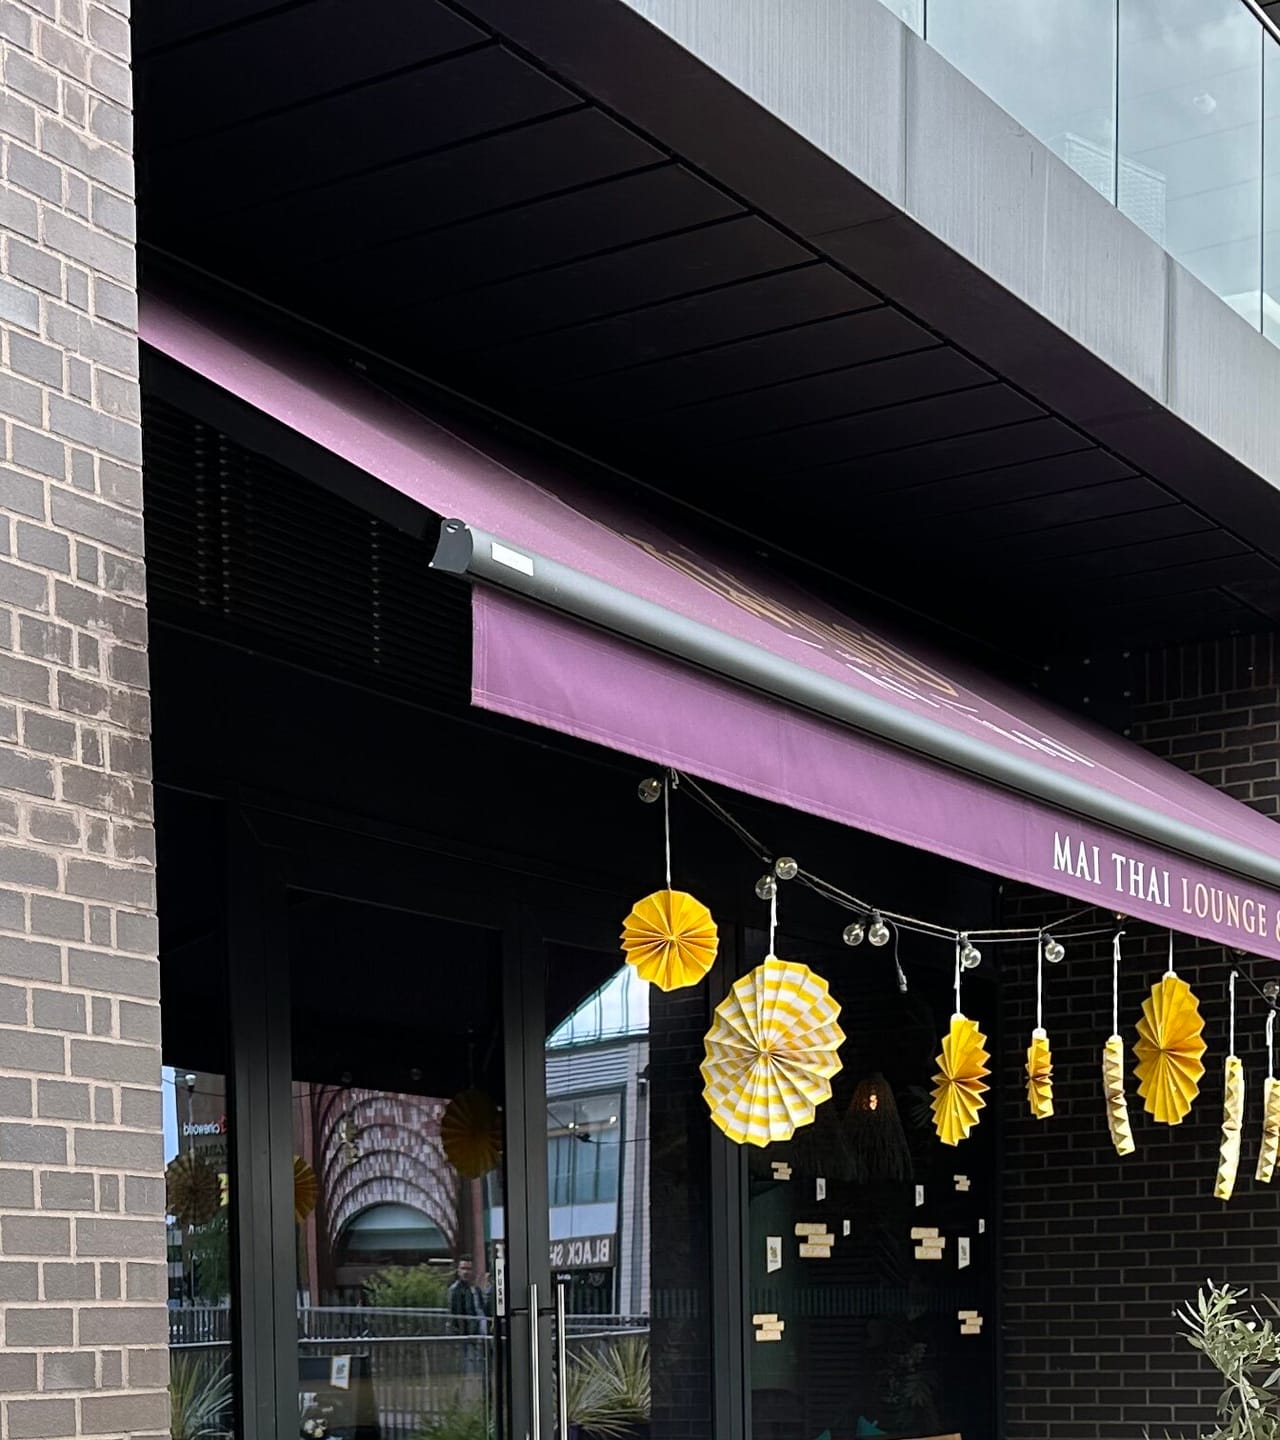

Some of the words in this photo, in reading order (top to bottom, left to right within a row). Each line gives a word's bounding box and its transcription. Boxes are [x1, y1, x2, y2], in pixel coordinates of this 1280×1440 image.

[1053, 831, 1102, 884] MAI
[1112, 852, 1171, 907] THAI
[1181, 877, 1267, 937] LOUNGE
